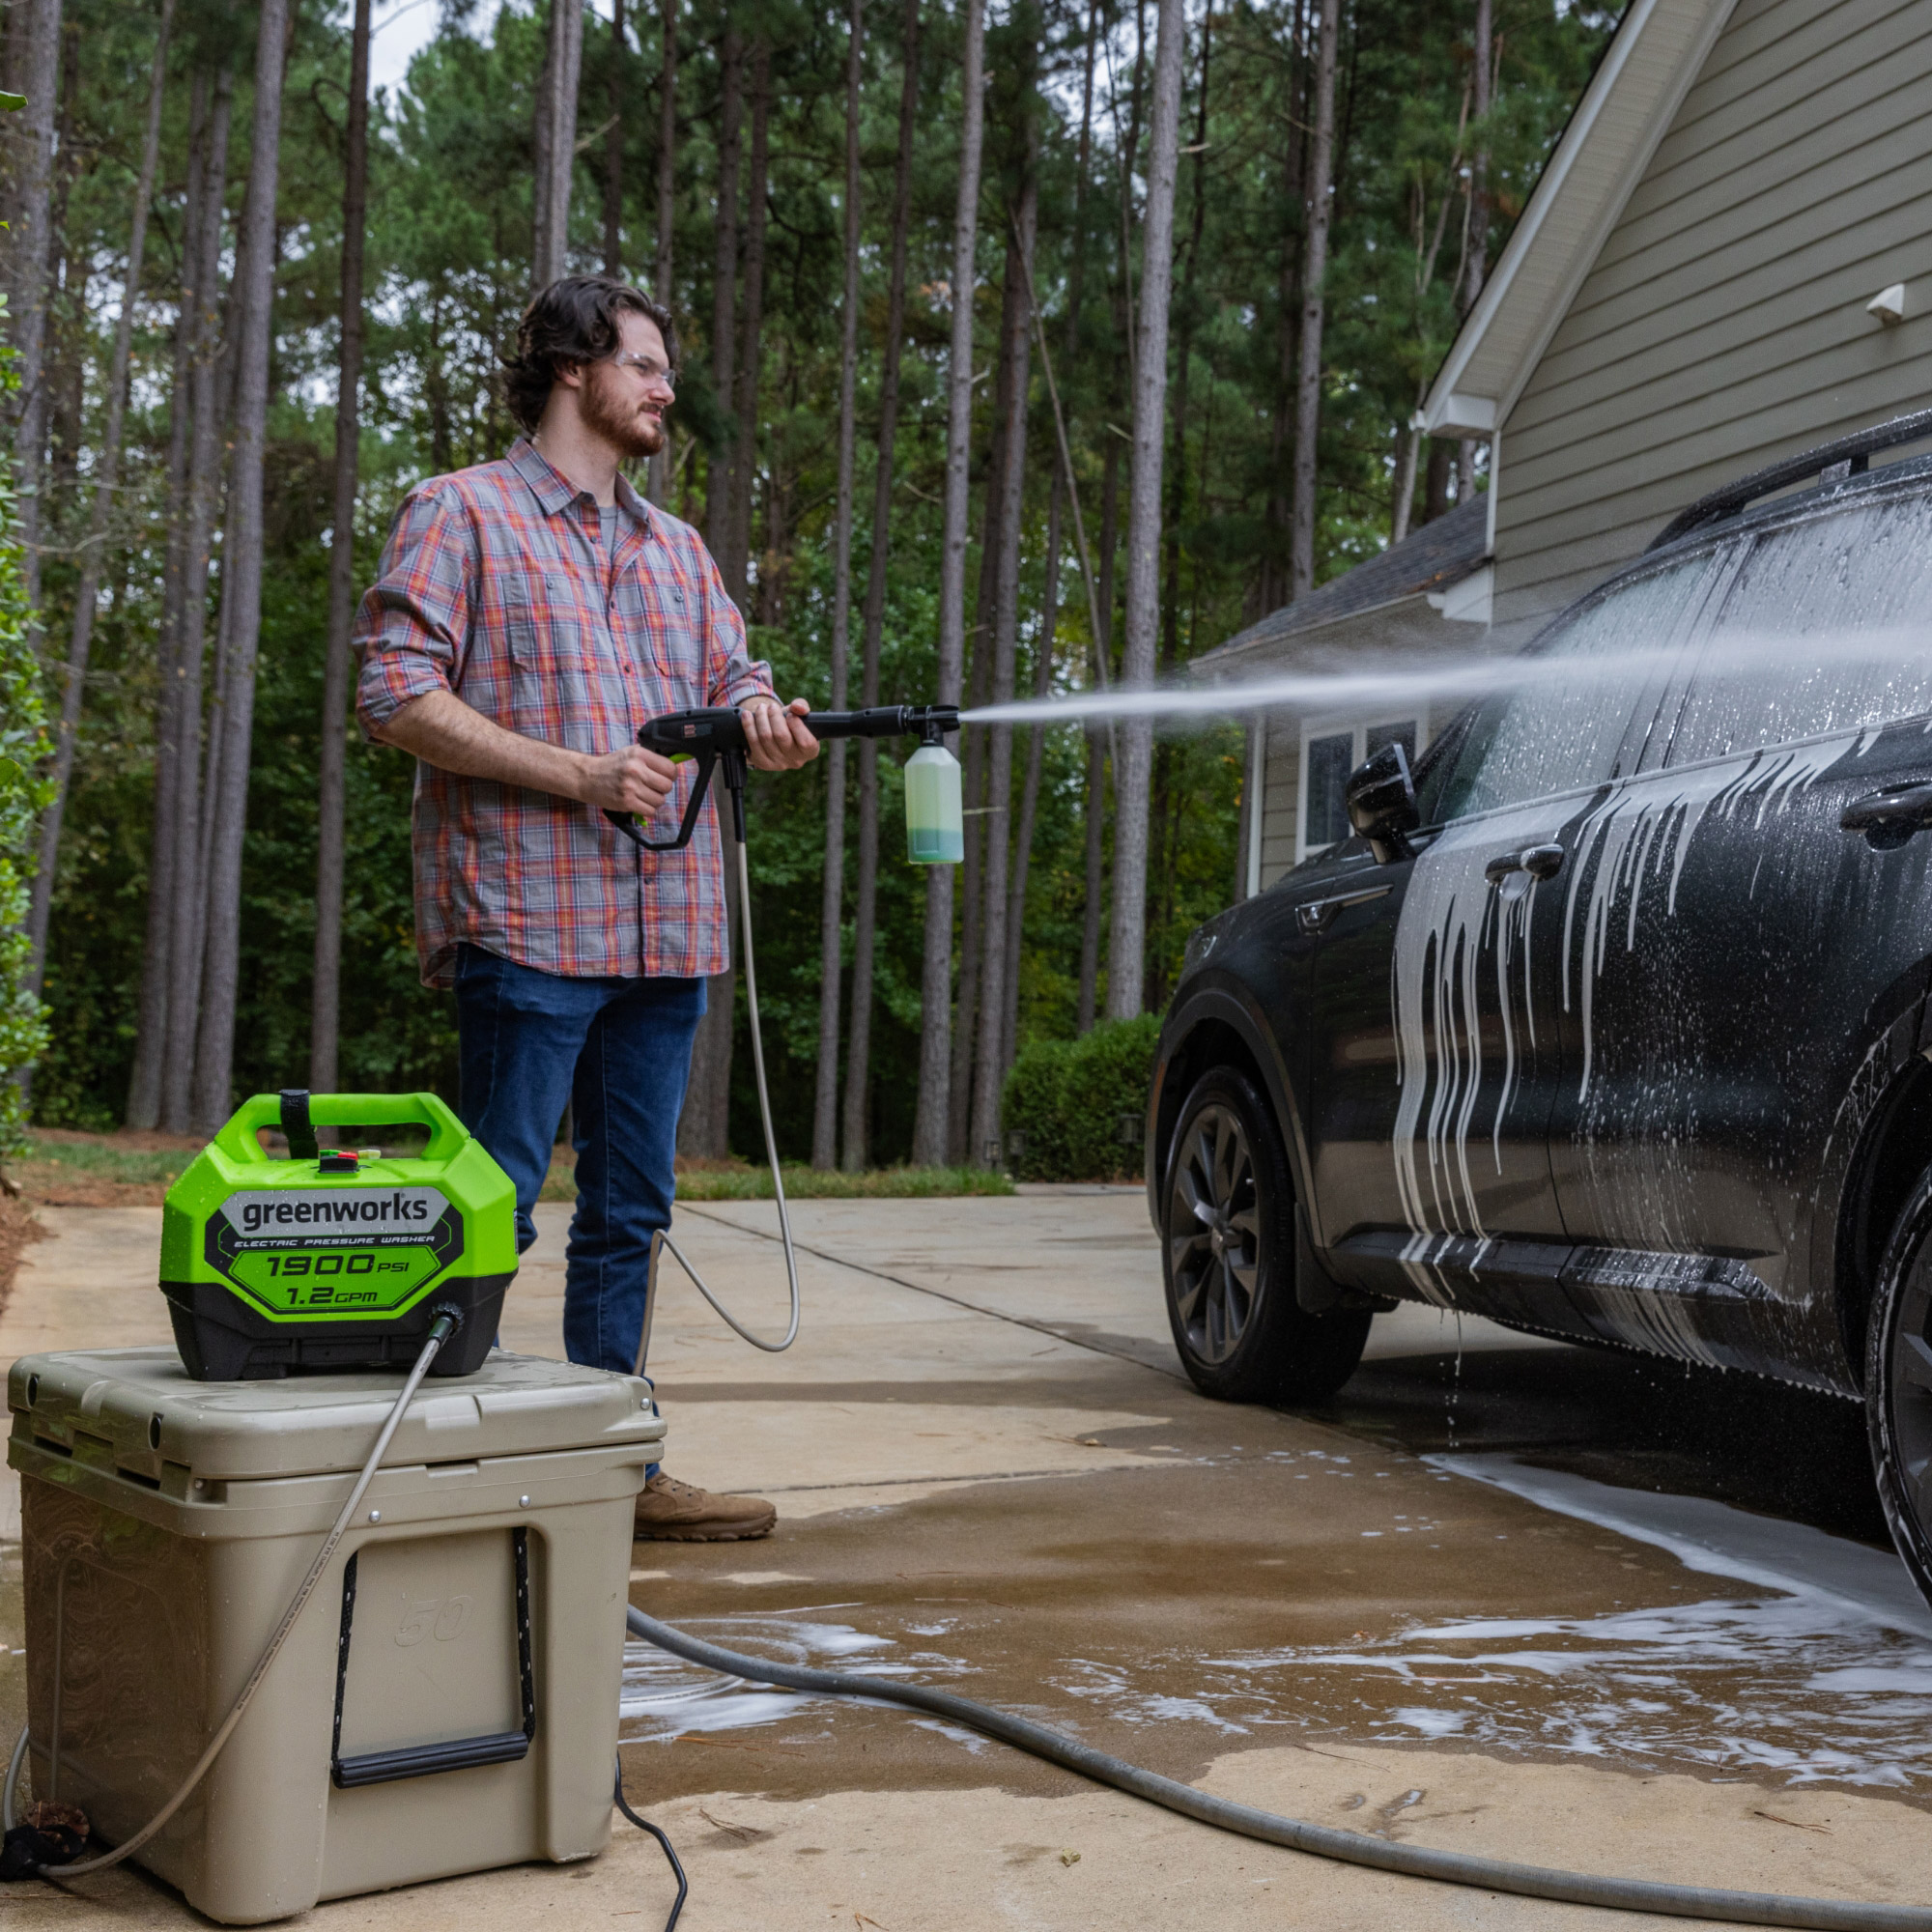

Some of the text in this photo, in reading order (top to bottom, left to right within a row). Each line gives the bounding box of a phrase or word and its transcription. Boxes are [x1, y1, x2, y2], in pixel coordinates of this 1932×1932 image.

[242, 1192, 428, 1232] greenworks
[234, 1236, 436, 1248] ELECTRIC PRESSURE WASHER
[267, 1254, 410, 1277] 1900 PSI
[394, 1595, 473, 1647] 50
